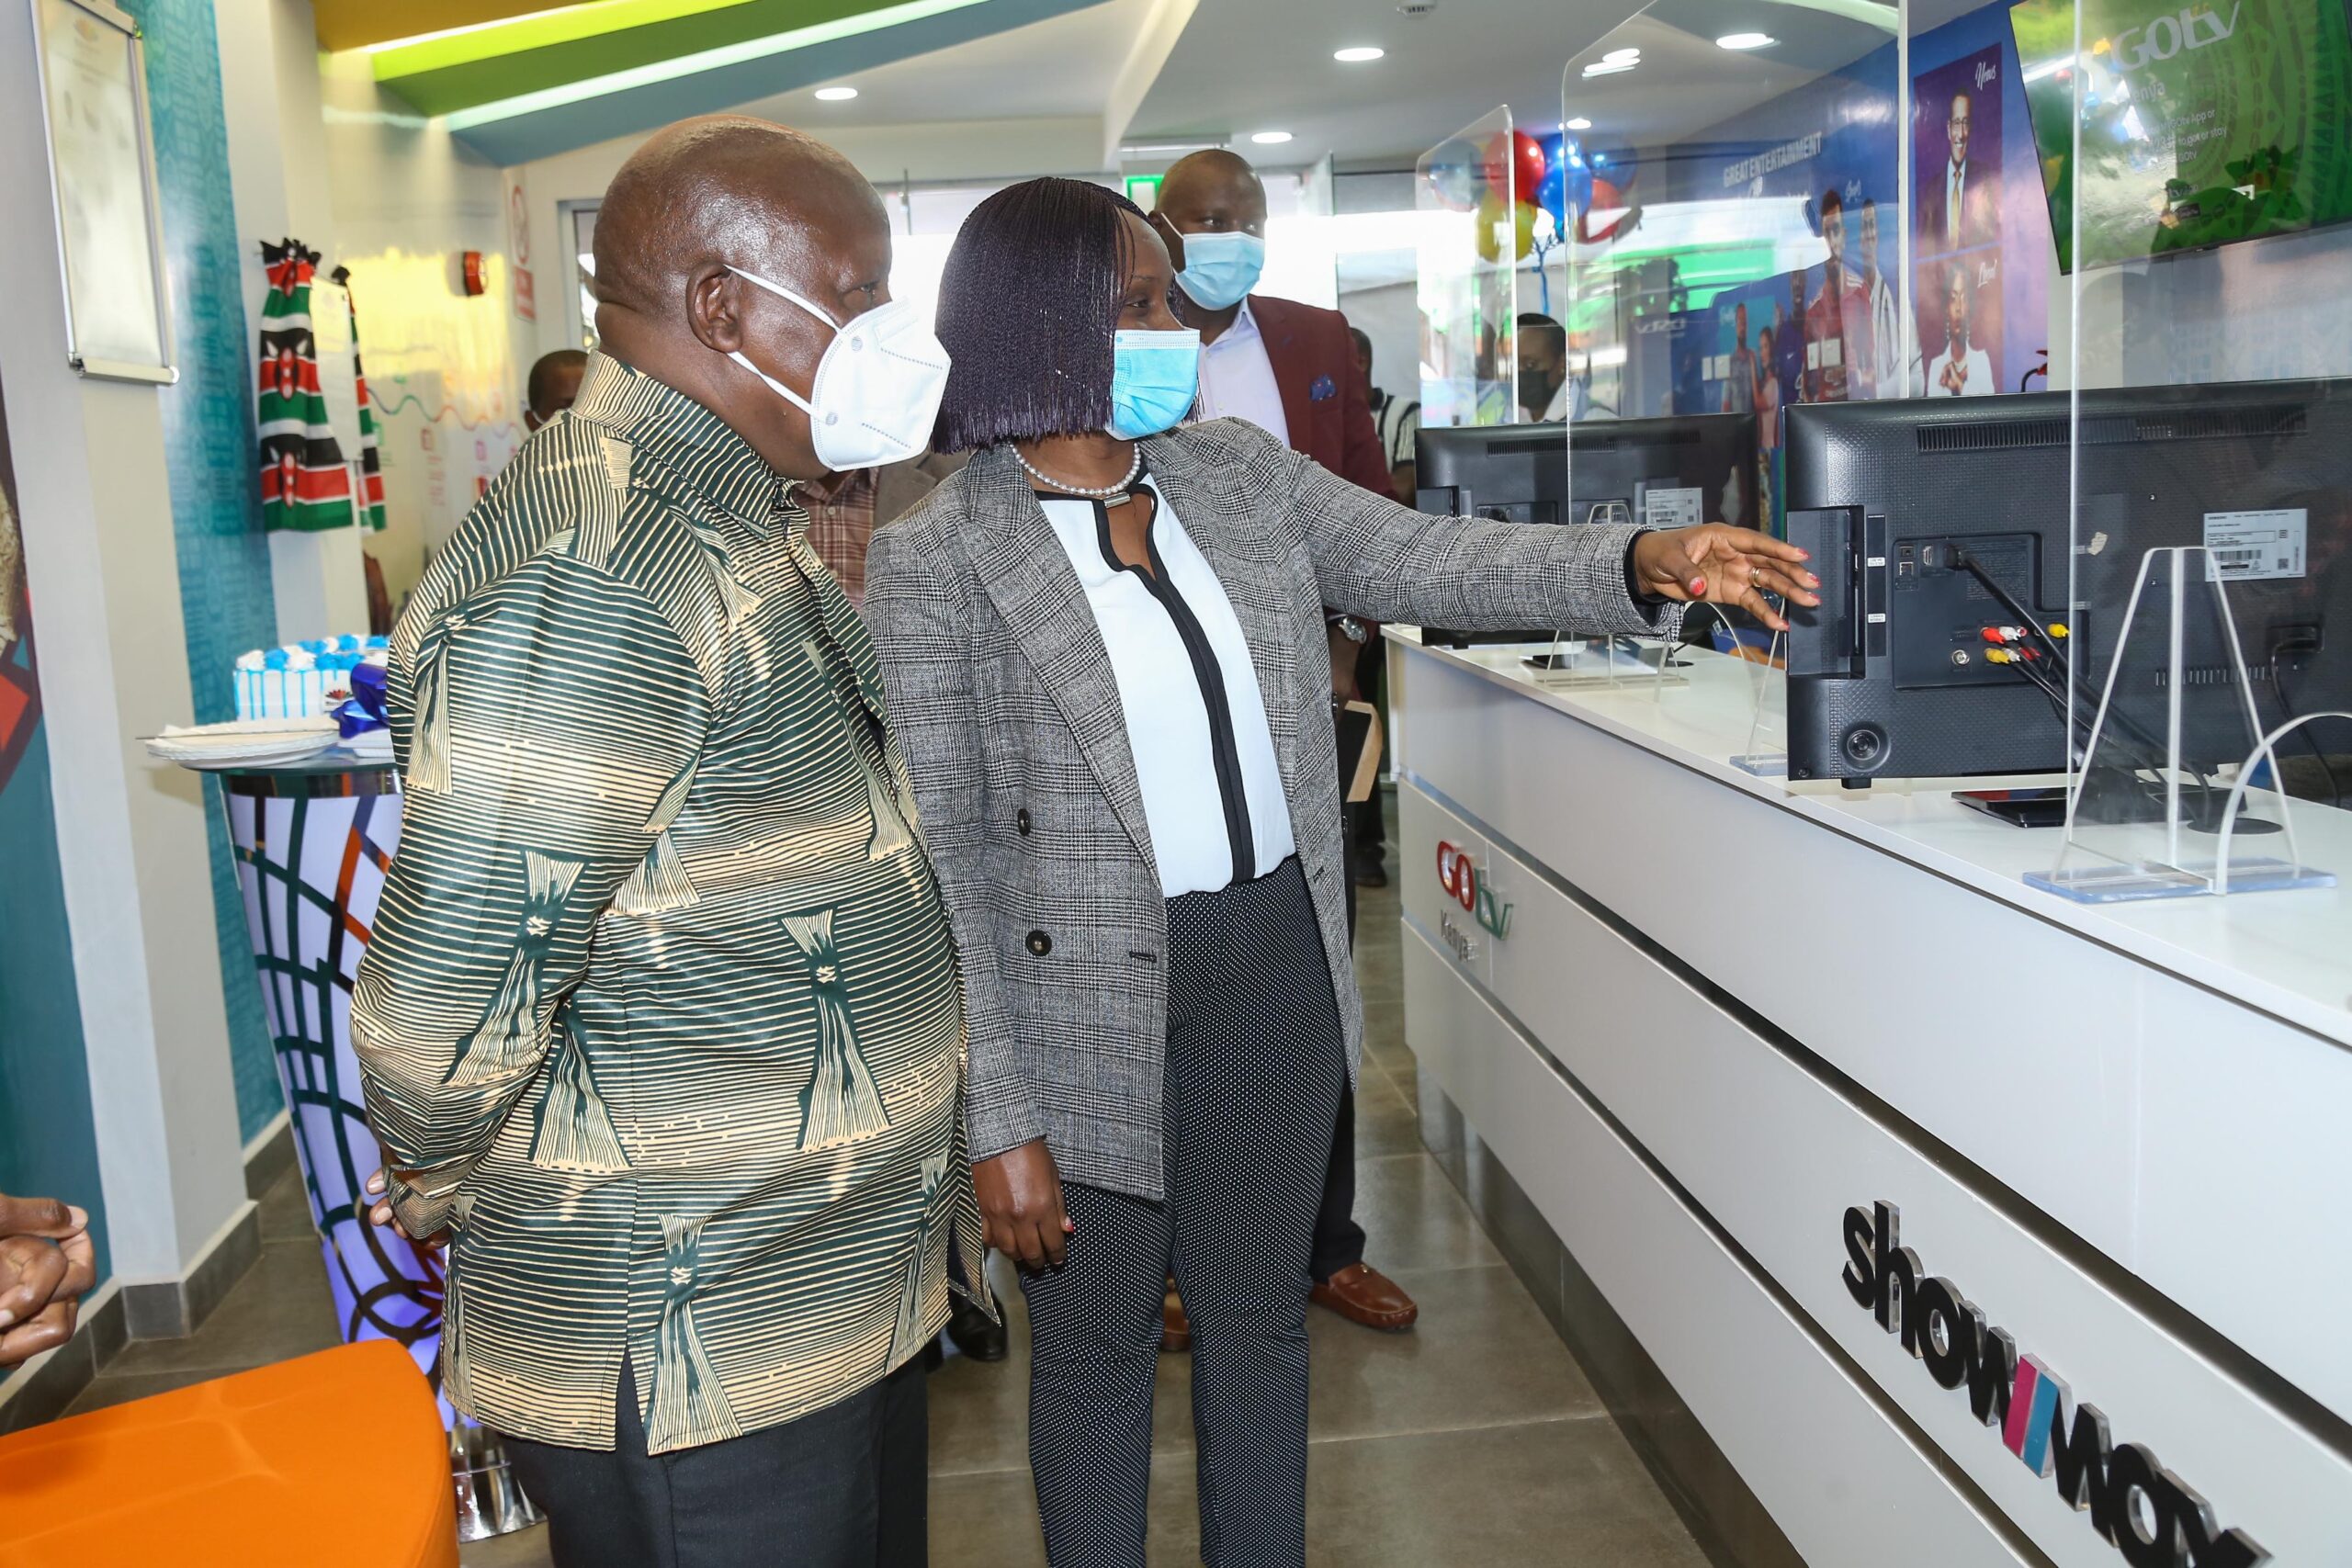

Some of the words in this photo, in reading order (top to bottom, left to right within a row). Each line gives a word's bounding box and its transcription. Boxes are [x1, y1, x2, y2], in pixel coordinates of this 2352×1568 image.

[2112, 0, 2240, 72] GOtv
[2132, 81, 2165, 104] enya
[2207, 109, 2216, 118] or
[2210, 125, 2227, 139] stay
[1724, 159, 1749, 188] GREAT
[1749, 130, 1823, 178] ENTERTAINMENT
[1437, 840, 1514, 941] GOtv
